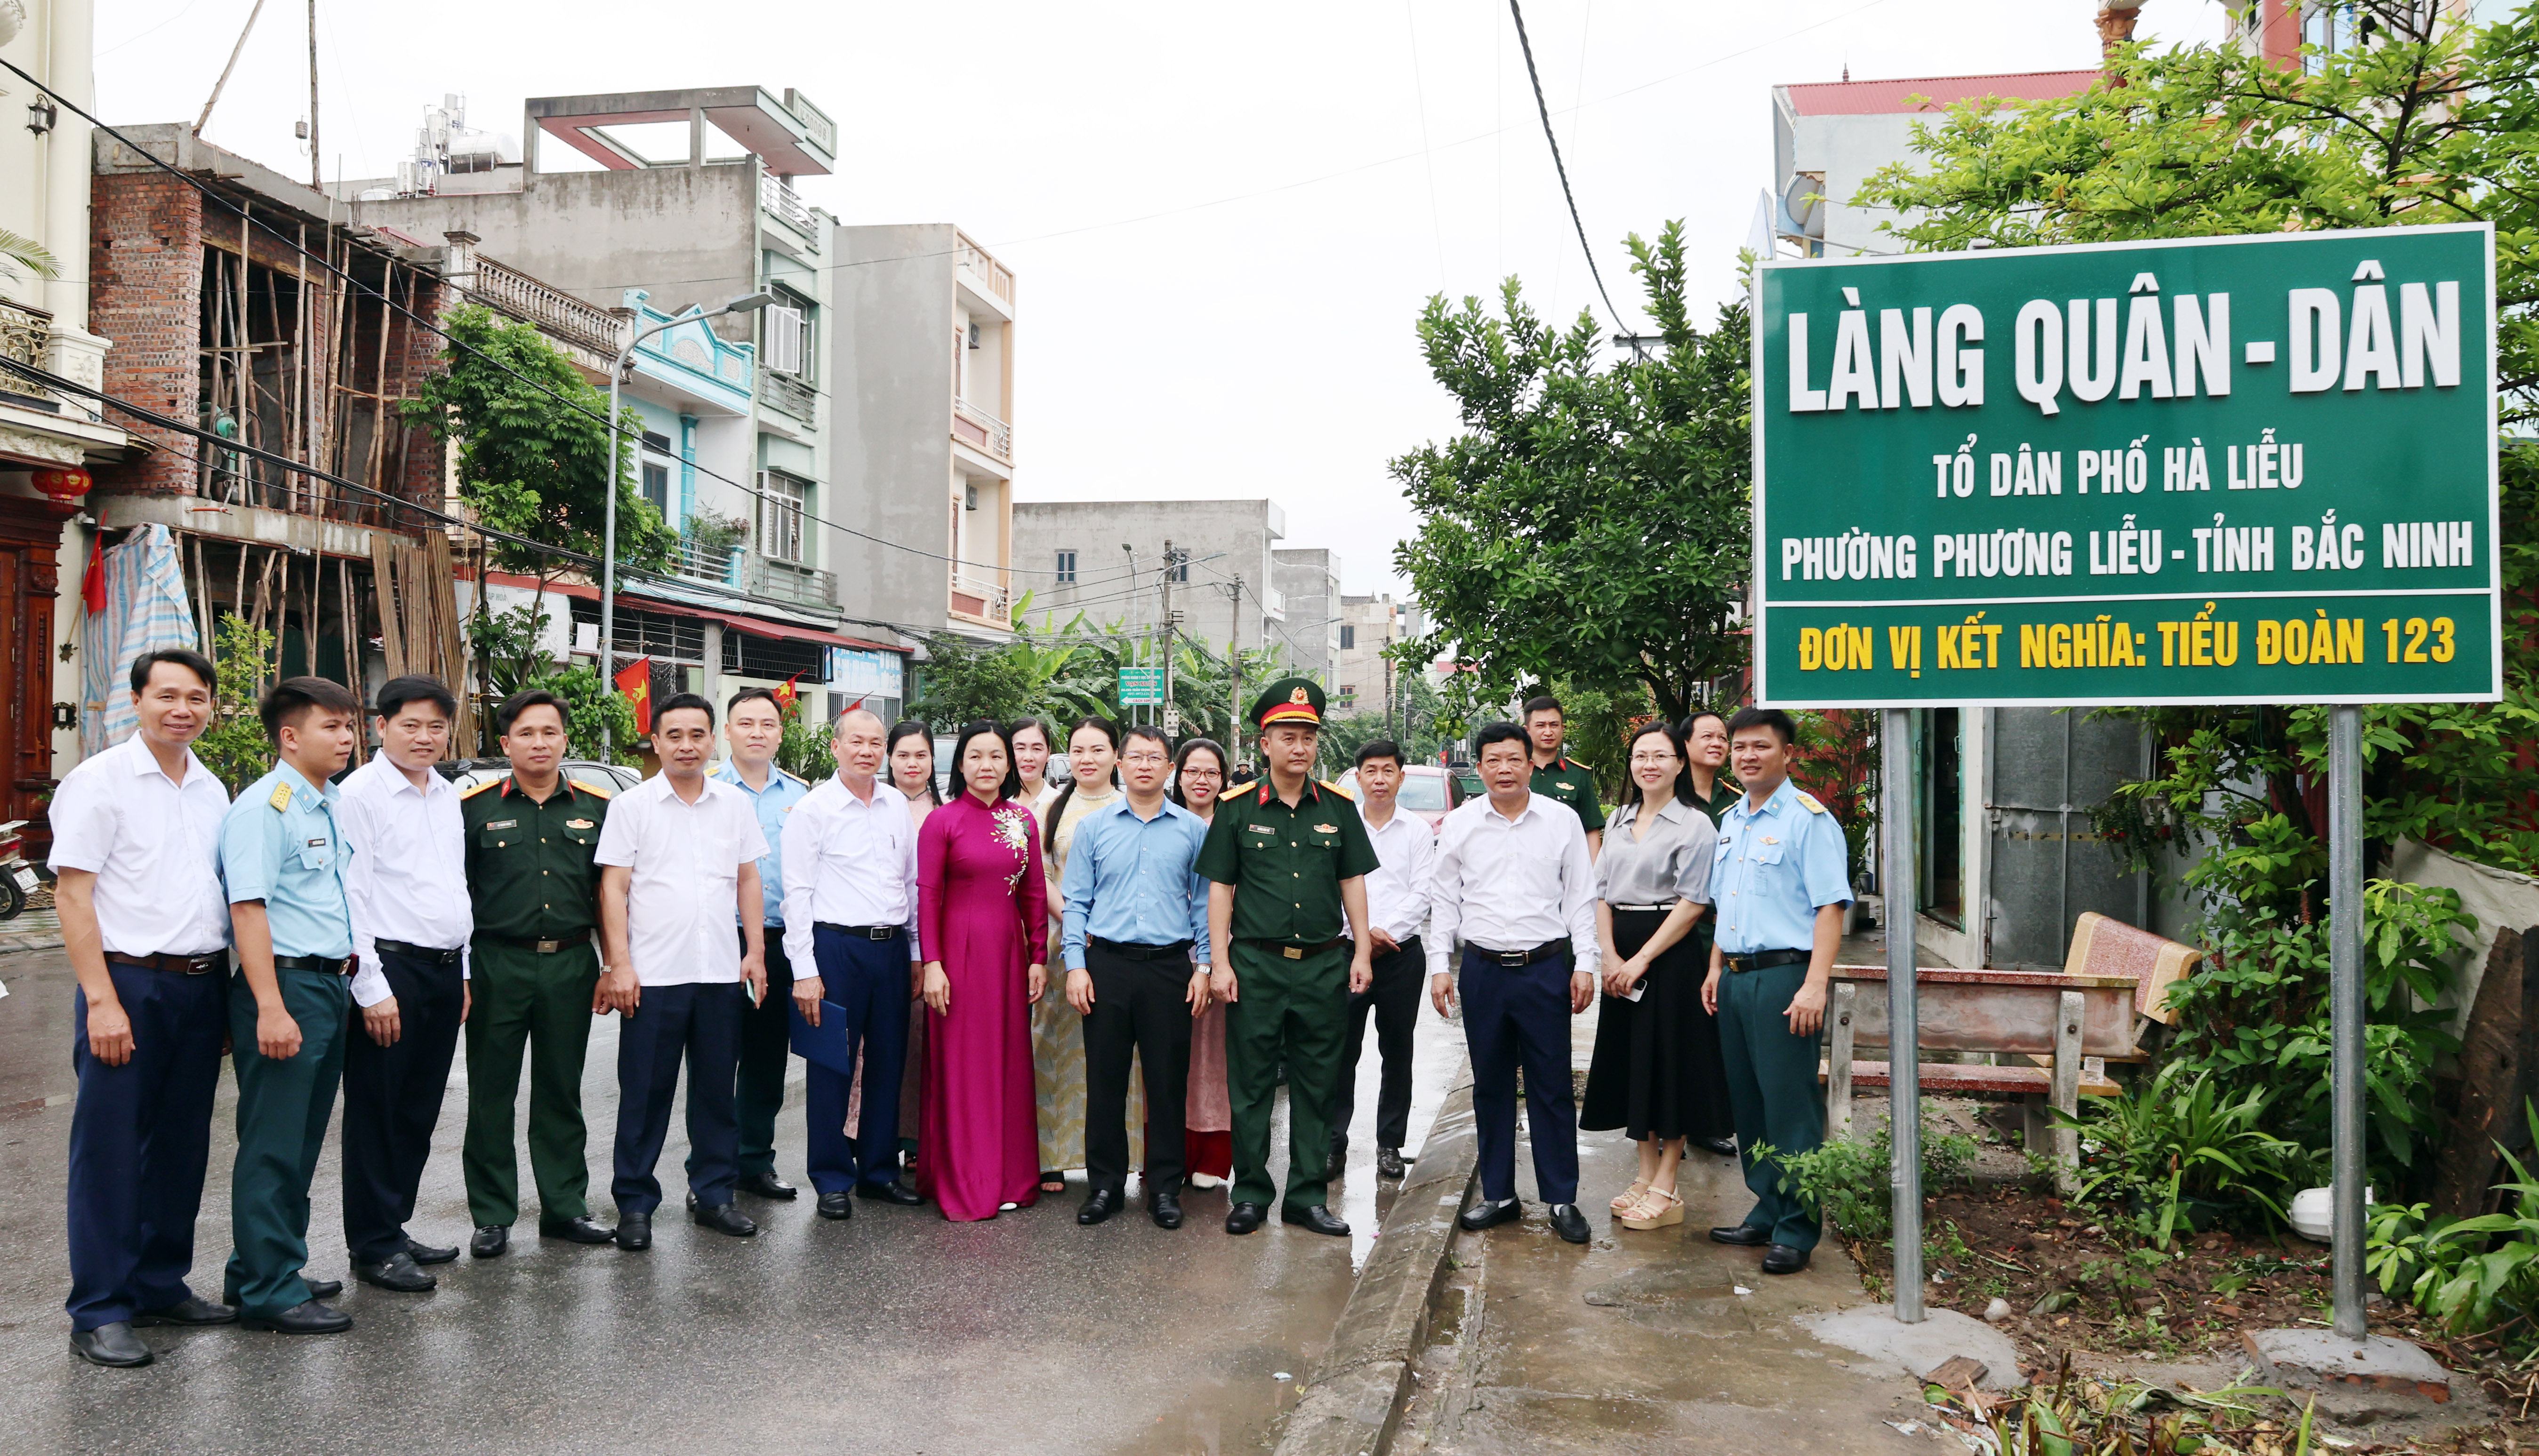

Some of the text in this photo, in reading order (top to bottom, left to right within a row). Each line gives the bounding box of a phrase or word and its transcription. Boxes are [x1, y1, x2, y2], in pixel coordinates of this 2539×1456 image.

[1789, 287, 1984, 411] LÀNG
[2016, 272, 2230, 415] QUÂN
[2289, 260, 2460, 392] DÂN
[1933, 428, 2303, 497] TỔ DÂN PHỐ HÀ LIỄU
[1782, 527, 1916, 580] PHƯỜNG
[1934, 528, 2072, 577] PHƯƠNG
[2090, 514, 2161, 574] LIỄU
[2193, 512, 2274, 572] TỈNH
[2292, 509, 2364, 570] BẮC
[2383, 521, 2472, 568] NINH
[1799, 601, 2455, 678] ĐƠN VỊ KẾT NGHĨA: TIỂU ĐOÀN 123
